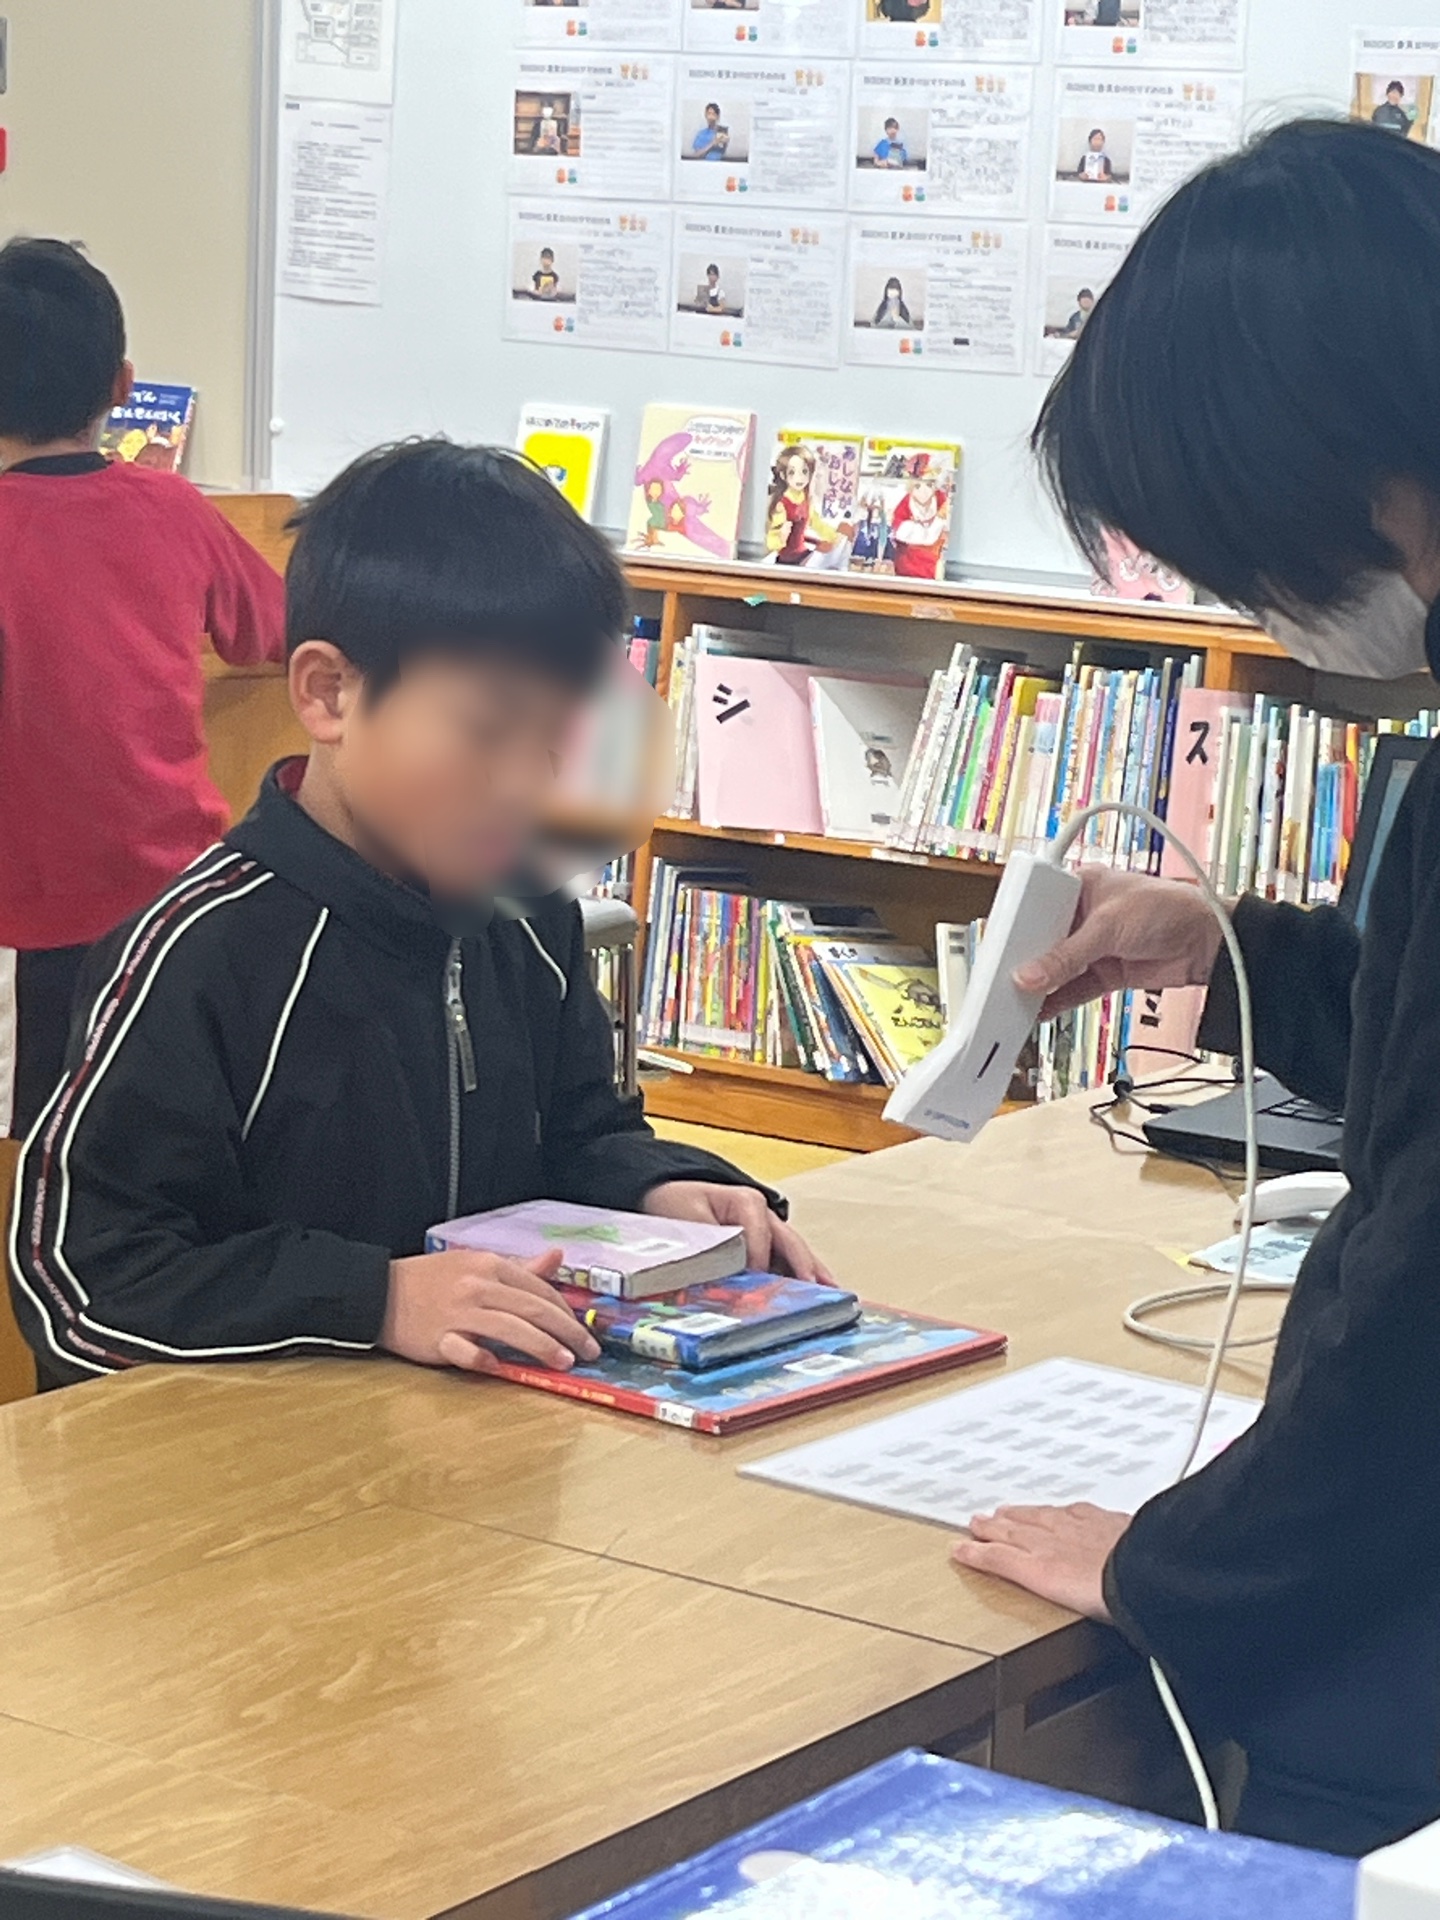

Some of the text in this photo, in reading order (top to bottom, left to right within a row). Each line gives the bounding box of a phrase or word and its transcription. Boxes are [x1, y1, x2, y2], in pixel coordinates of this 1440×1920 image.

[821, 454, 841, 518] おじさん
[838, 446, 856, 509] あしなが
[713, 683, 751, 724] シ
[1186, 721, 1210, 765] ス
